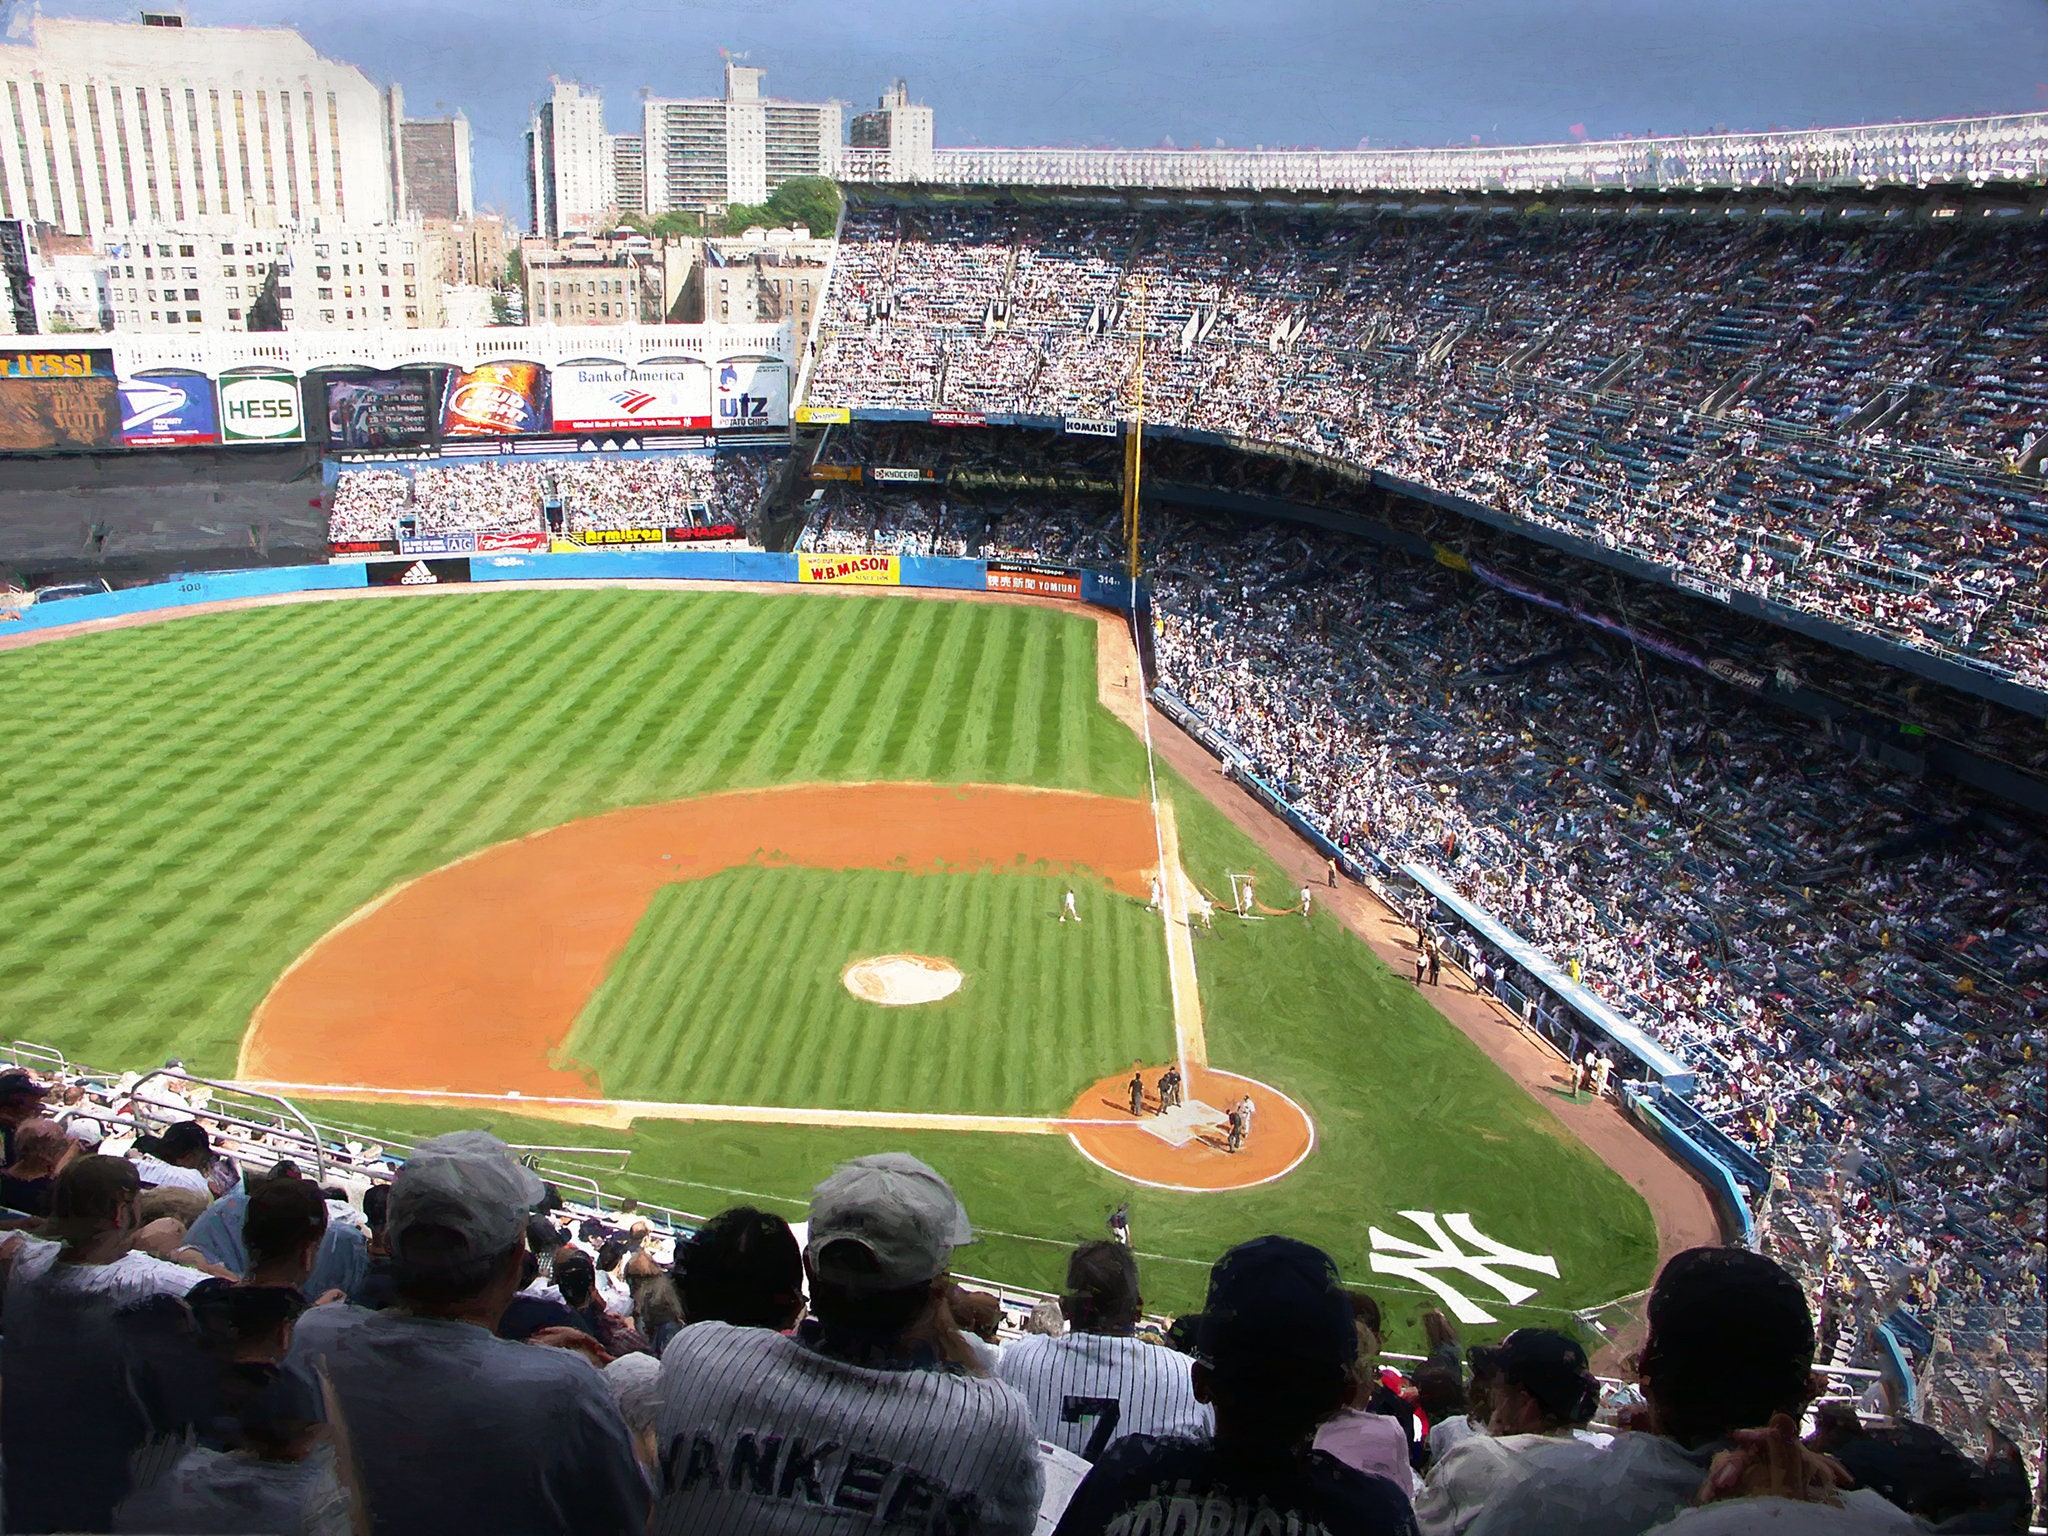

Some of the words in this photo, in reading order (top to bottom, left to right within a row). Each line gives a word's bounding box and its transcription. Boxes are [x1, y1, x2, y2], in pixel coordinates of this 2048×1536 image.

[18, 354, 93, 376] LESS!
[578, 370, 612, 382] Bank
[614, 370, 627, 381] of
[630, 370, 684, 381] America
[472, 387, 525, 409] BUD
[229, 399, 293, 419] HESS
[461, 397, 528, 423] LIGHT
[720, 418, 746, 426] POTATO
[747, 418, 769, 426] CHIPS
[1066, 421, 1117, 434] KOMATSU
[584, 529, 662, 544] Armitron
[674, 525, 736, 538] SHARP
[1000, 564, 1022, 572] Japan's
[1097, 574, 1114, 585] 314
[1039, 581, 1077, 593] YOMIURI
[1733, 671, 1761, 687] LIGHT
[1062, 1395, 1120, 1463] 7
